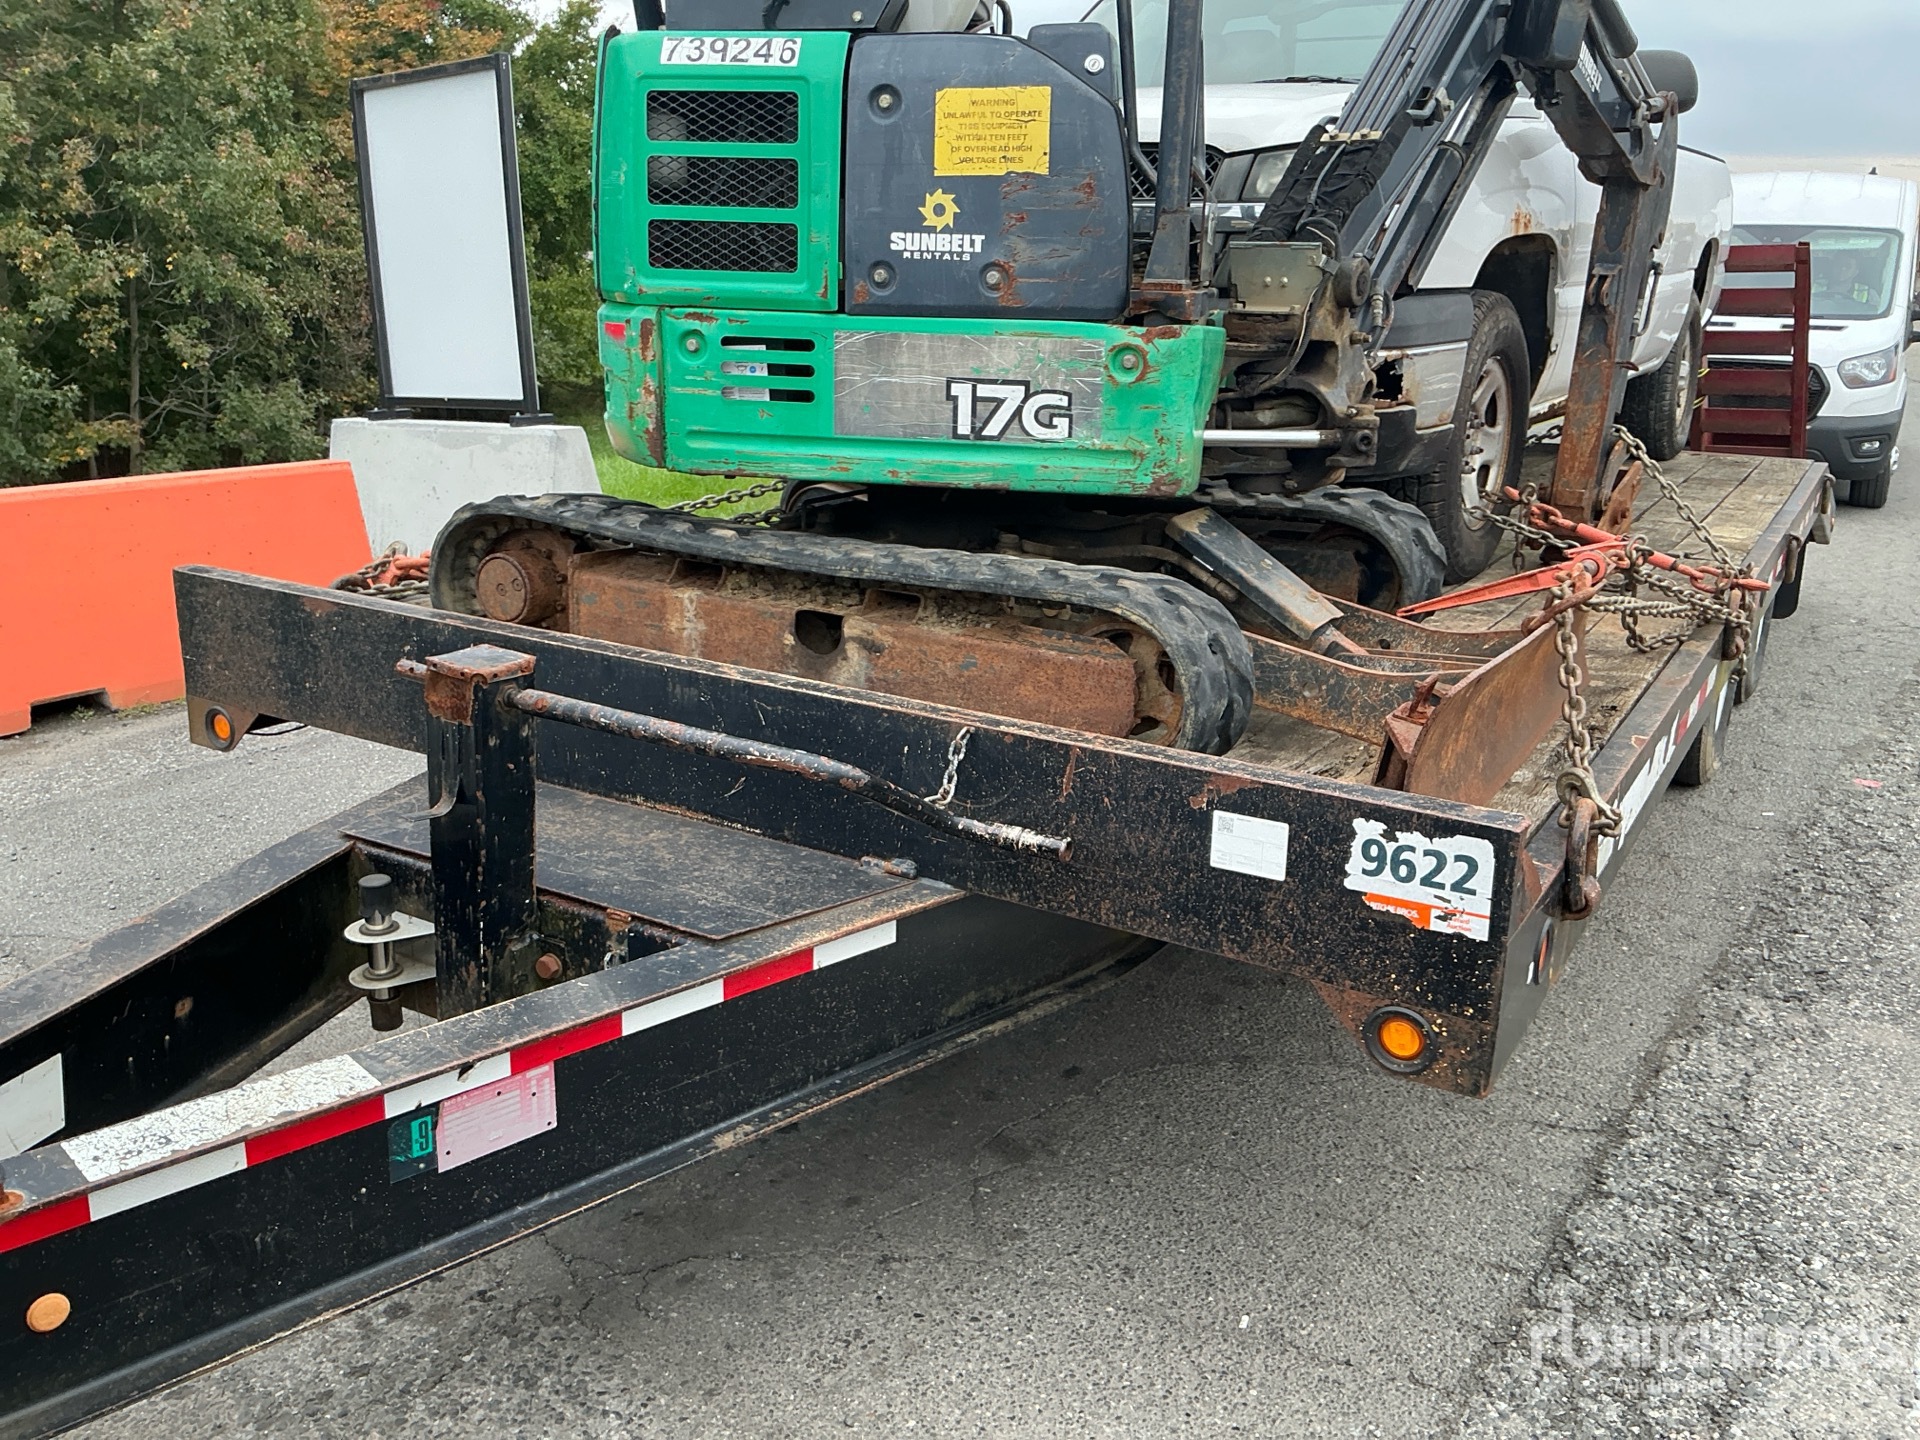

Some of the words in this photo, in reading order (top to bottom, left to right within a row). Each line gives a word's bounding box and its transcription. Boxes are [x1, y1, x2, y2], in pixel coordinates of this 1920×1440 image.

[665, 37, 798, 64] 739246
[970, 98, 1016, 107] WARNING
[943, 111, 988, 119] UNLAWFUL
[990, 111, 1002, 119] TO
[1003, 110, 1043, 118] OPERATE
[981, 122, 1028, 130] EQUIPMENT
[955, 133, 987, 141] WITHIN
[989, 133, 1006, 141] TEN
[1007, 133, 1028, 141] FEET
[963, 145, 1011, 153] OVERHEAD
[958, 156, 998, 164] VOLTAGE
[998, 156, 1024, 164] LINES
[890, 232, 985, 252] SUNBELT
[903, 251, 971, 261] RENTALS
[946, 377, 1073, 442] 17G
[1361, 838, 1479, 896] 9622
